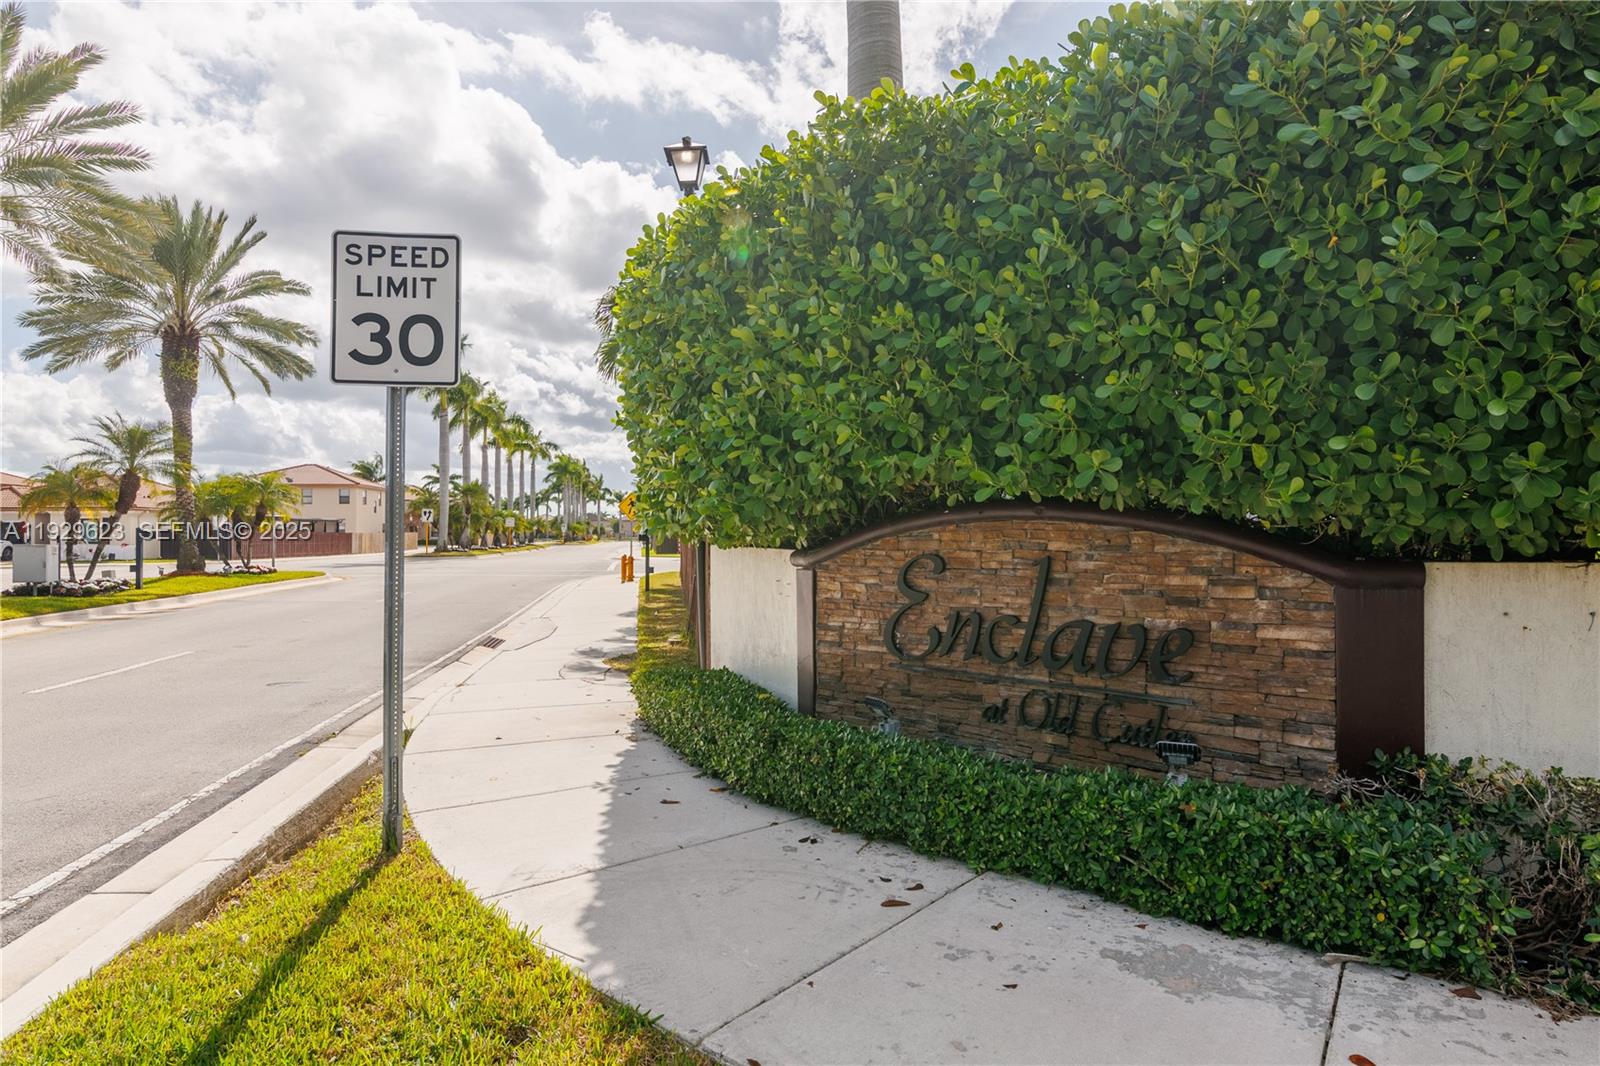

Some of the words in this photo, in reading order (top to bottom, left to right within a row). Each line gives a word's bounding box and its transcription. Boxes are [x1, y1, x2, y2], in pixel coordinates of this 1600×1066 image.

[345, 243, 449, 268] SPEED
[356, 275, 437, 299] LIMIT
[348, 312, 444, 366] 30
[884, 553, 1194, 683] Enclave
[982, 699, 1008, 724] at
[1018, 689, 1080, 734] Old
